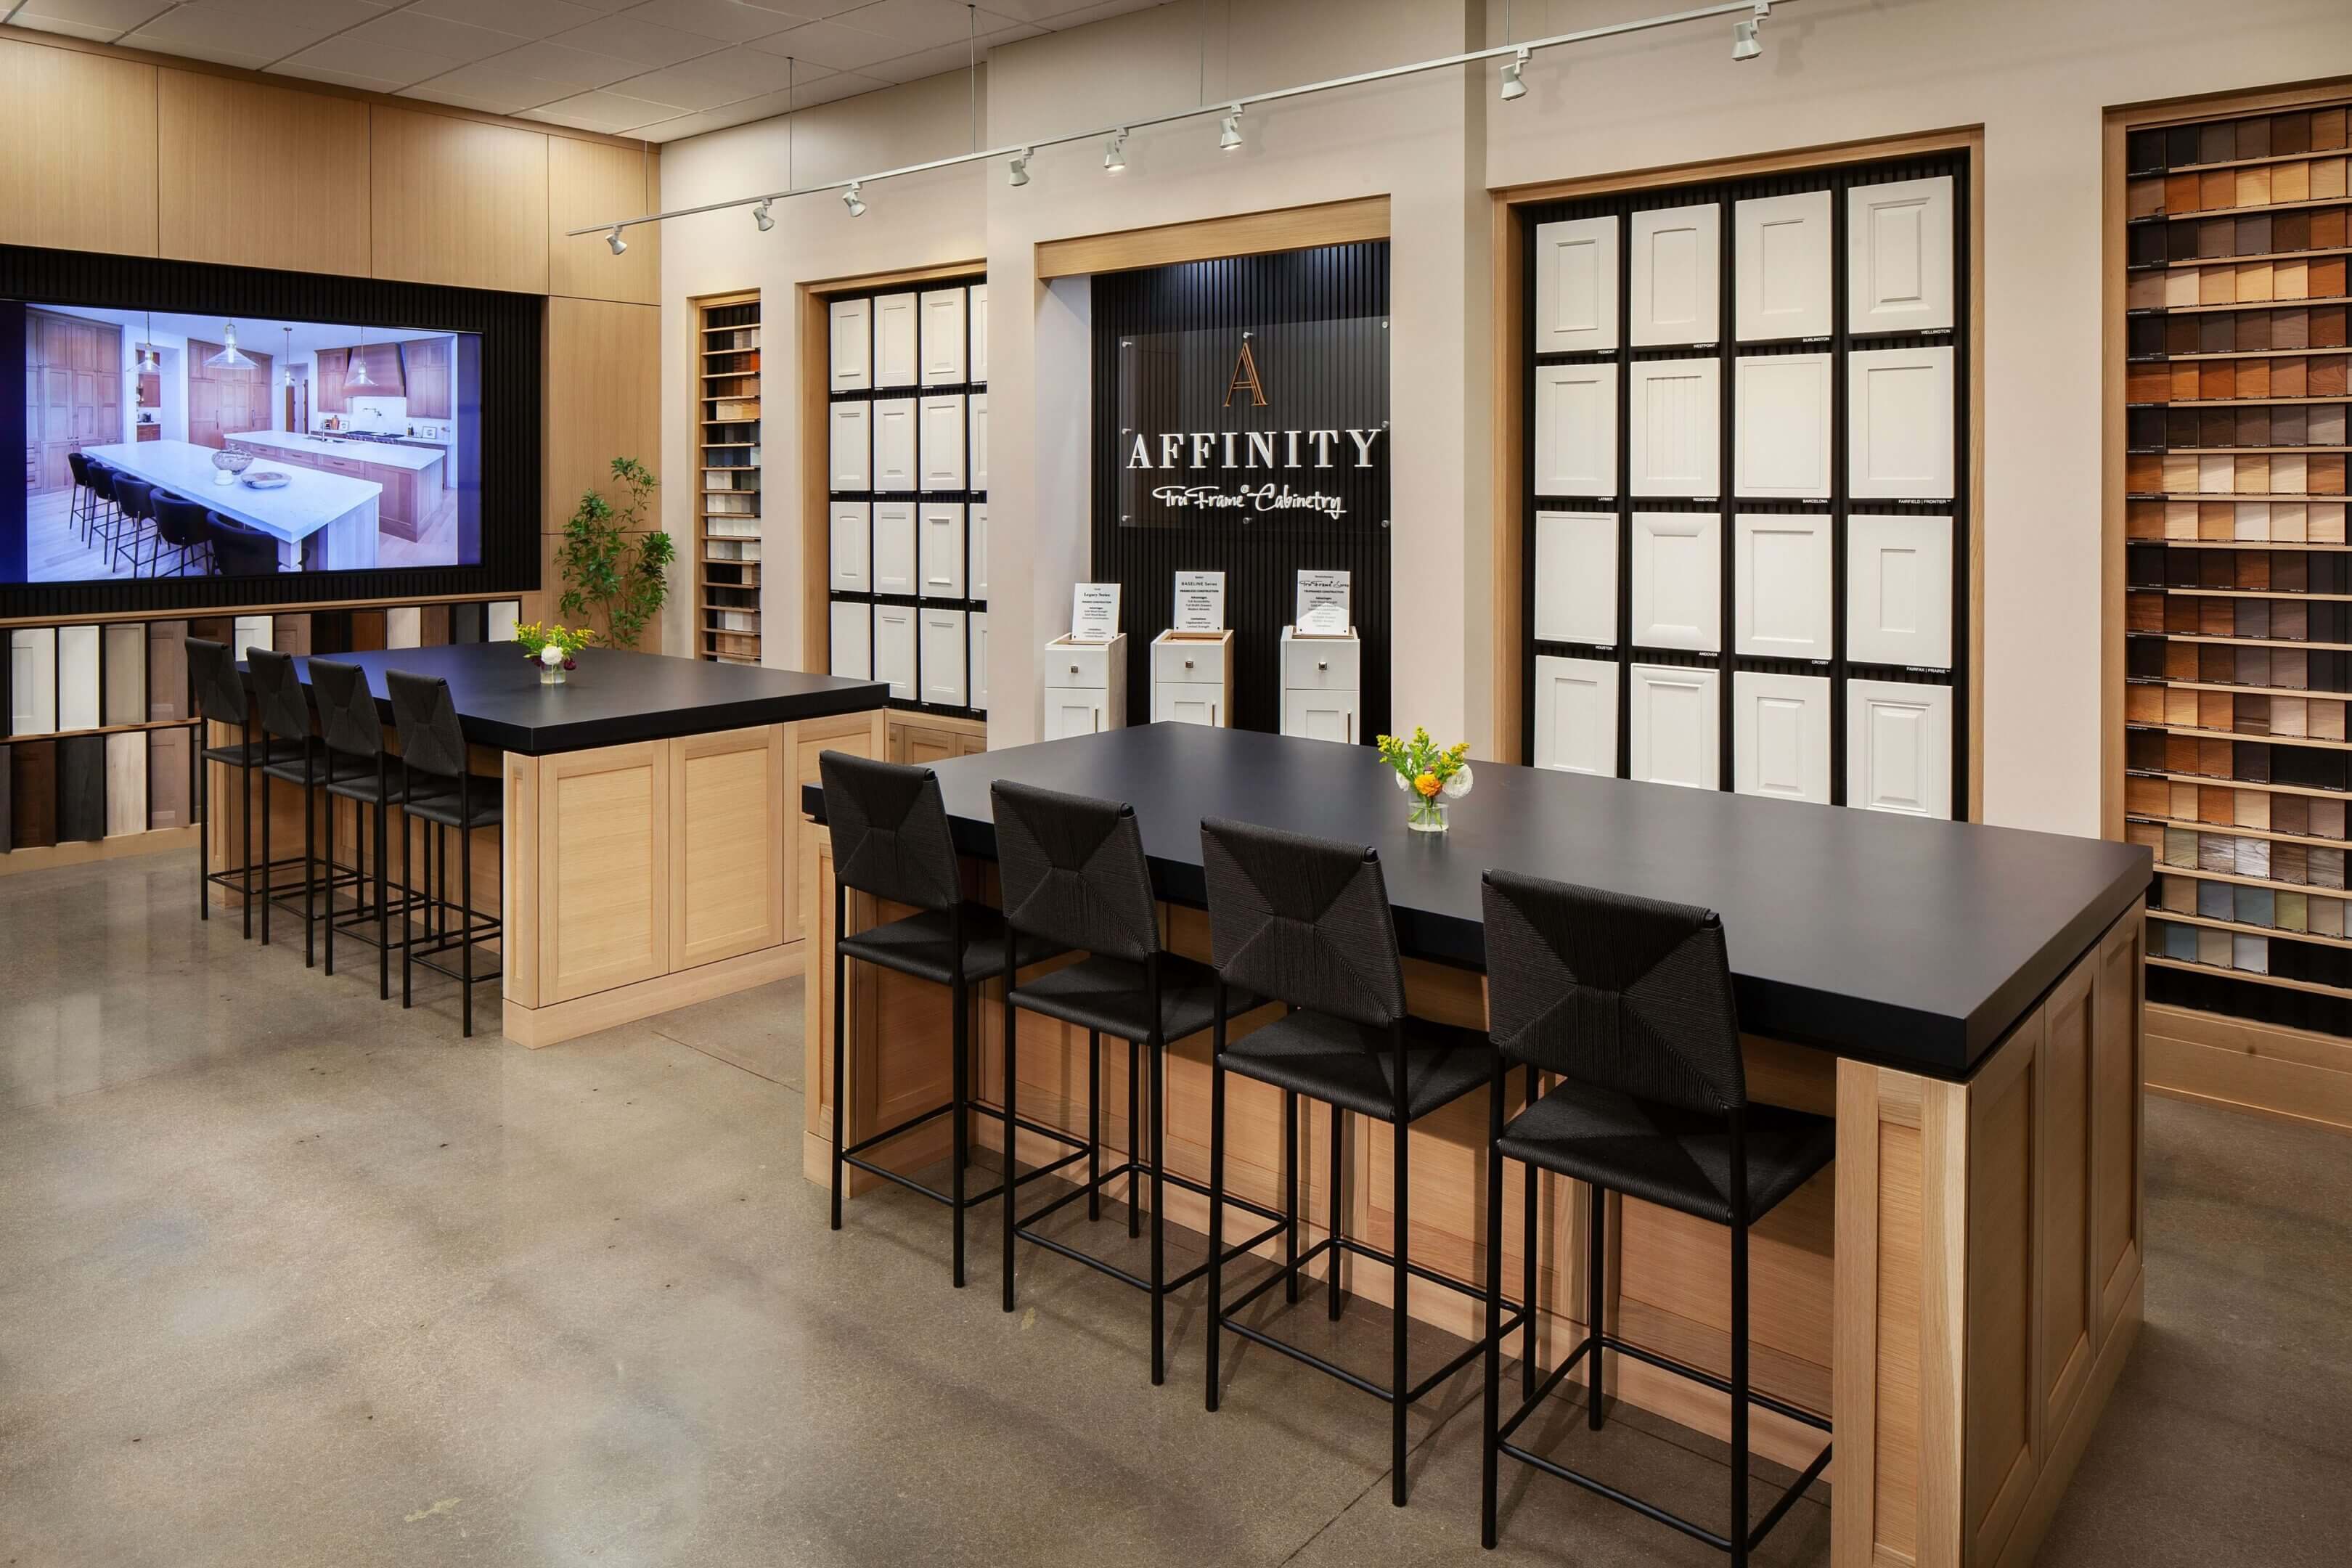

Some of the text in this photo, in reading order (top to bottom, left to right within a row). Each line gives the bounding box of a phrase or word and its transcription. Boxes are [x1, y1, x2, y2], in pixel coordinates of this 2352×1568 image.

[1222, 342, 1269, 407] A
[1126, 429, 1381, 469] AFFINITY
[1246, 483, 1347, 520] Cabinetry
